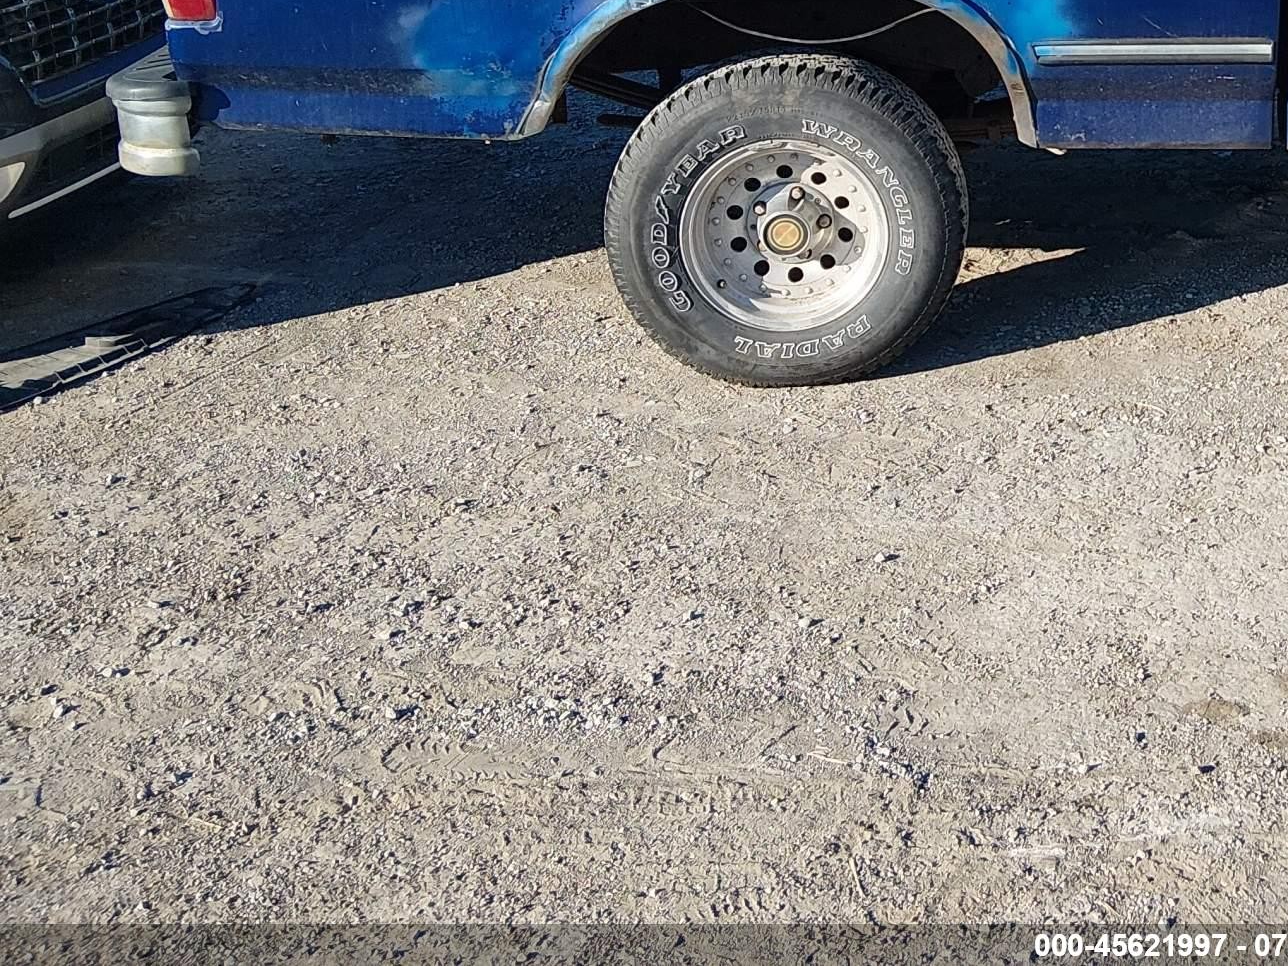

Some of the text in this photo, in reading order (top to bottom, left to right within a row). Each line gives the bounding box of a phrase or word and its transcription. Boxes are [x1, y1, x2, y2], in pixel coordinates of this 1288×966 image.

[651, 124, 747, 312] GOODYEAR
[802, 119, 916, 276] WRANGLER
[734, 315, 873, 359] RADIAL
